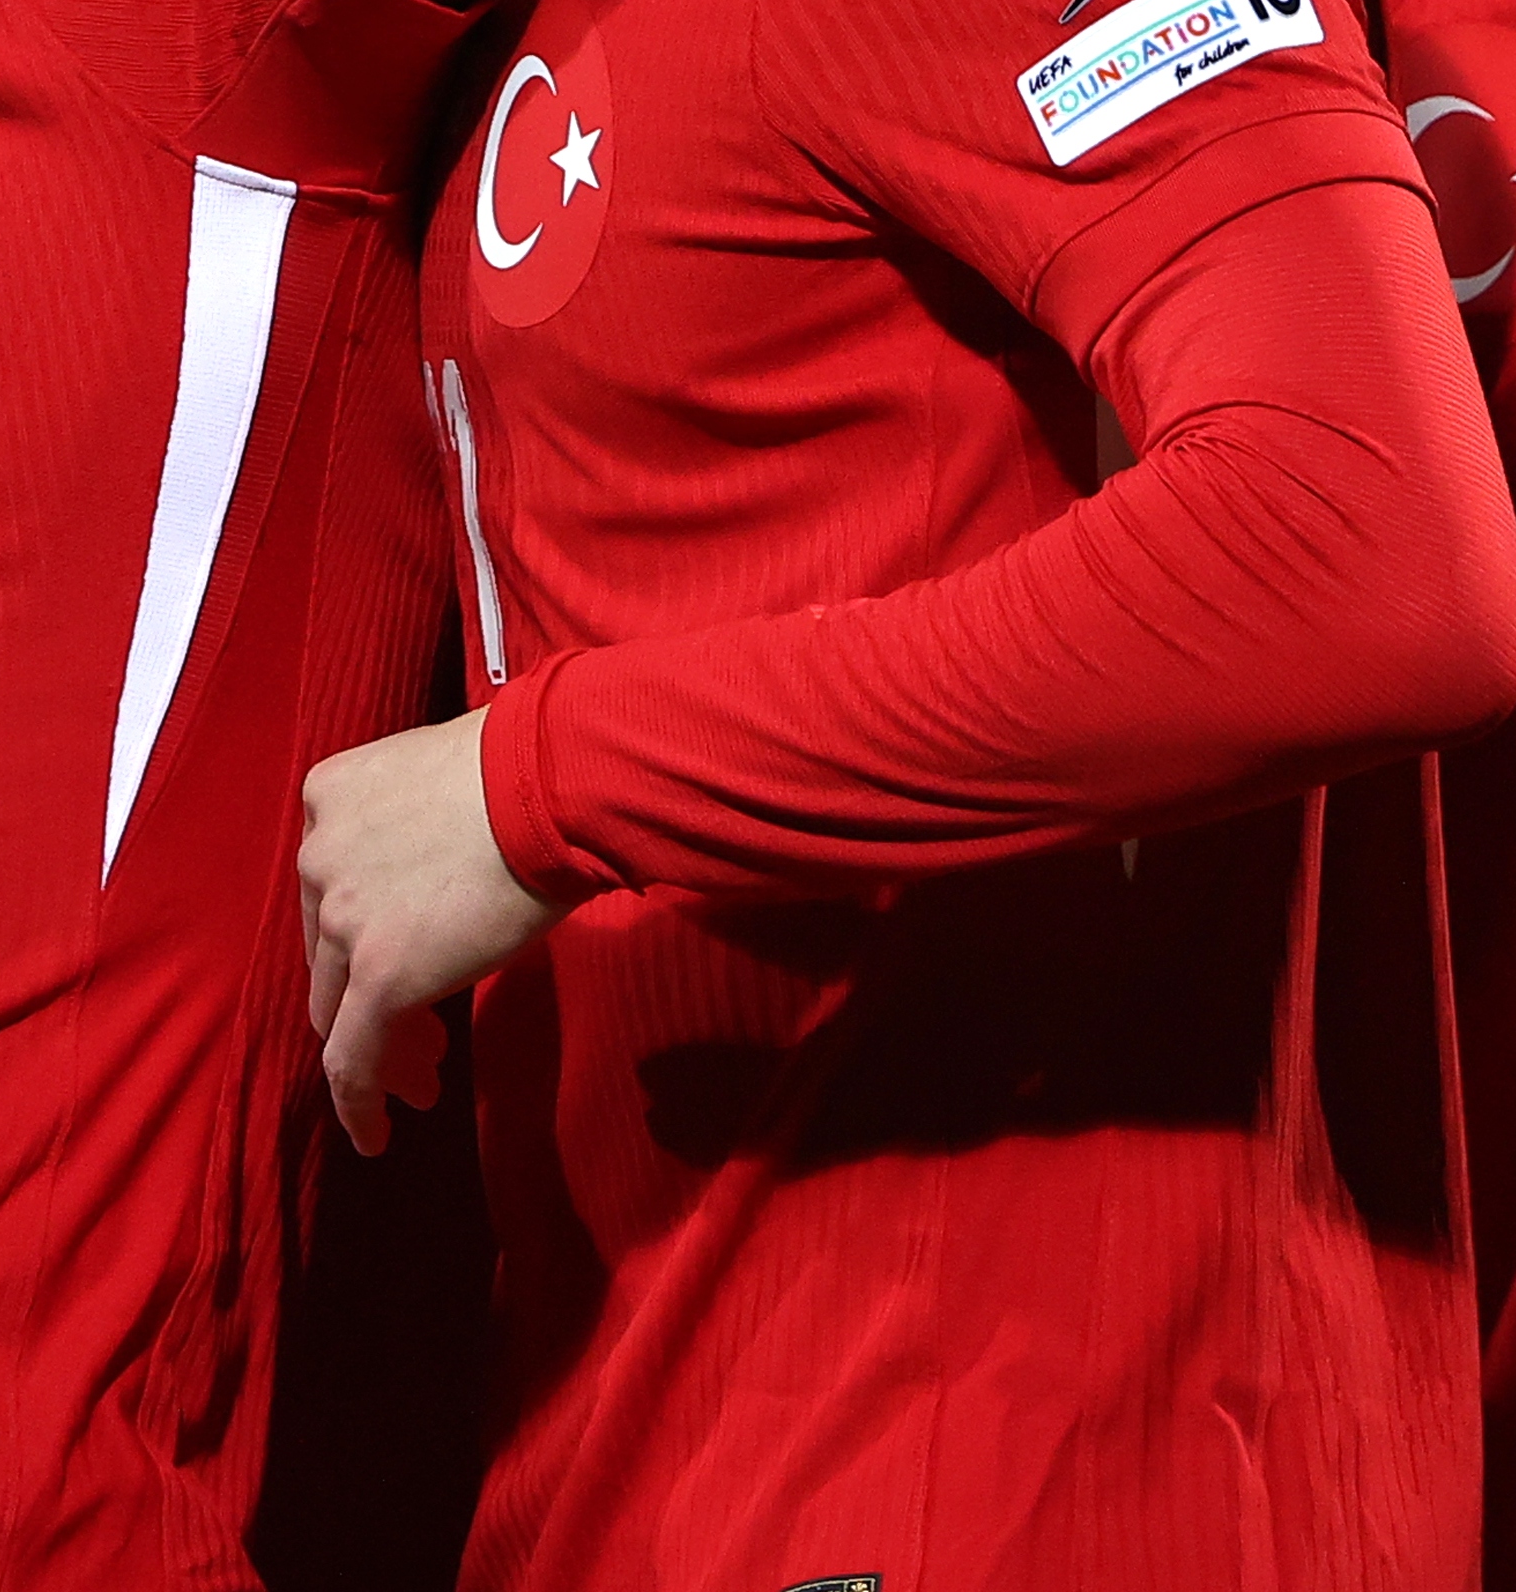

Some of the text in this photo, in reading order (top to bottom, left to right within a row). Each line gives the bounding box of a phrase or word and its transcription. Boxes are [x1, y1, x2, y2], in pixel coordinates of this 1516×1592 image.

[1028, 55, 1072, 96] UEFA
[1040, 0, 1237, 127] FOUNDATION
[1173, 38, 1250, 87] for children
